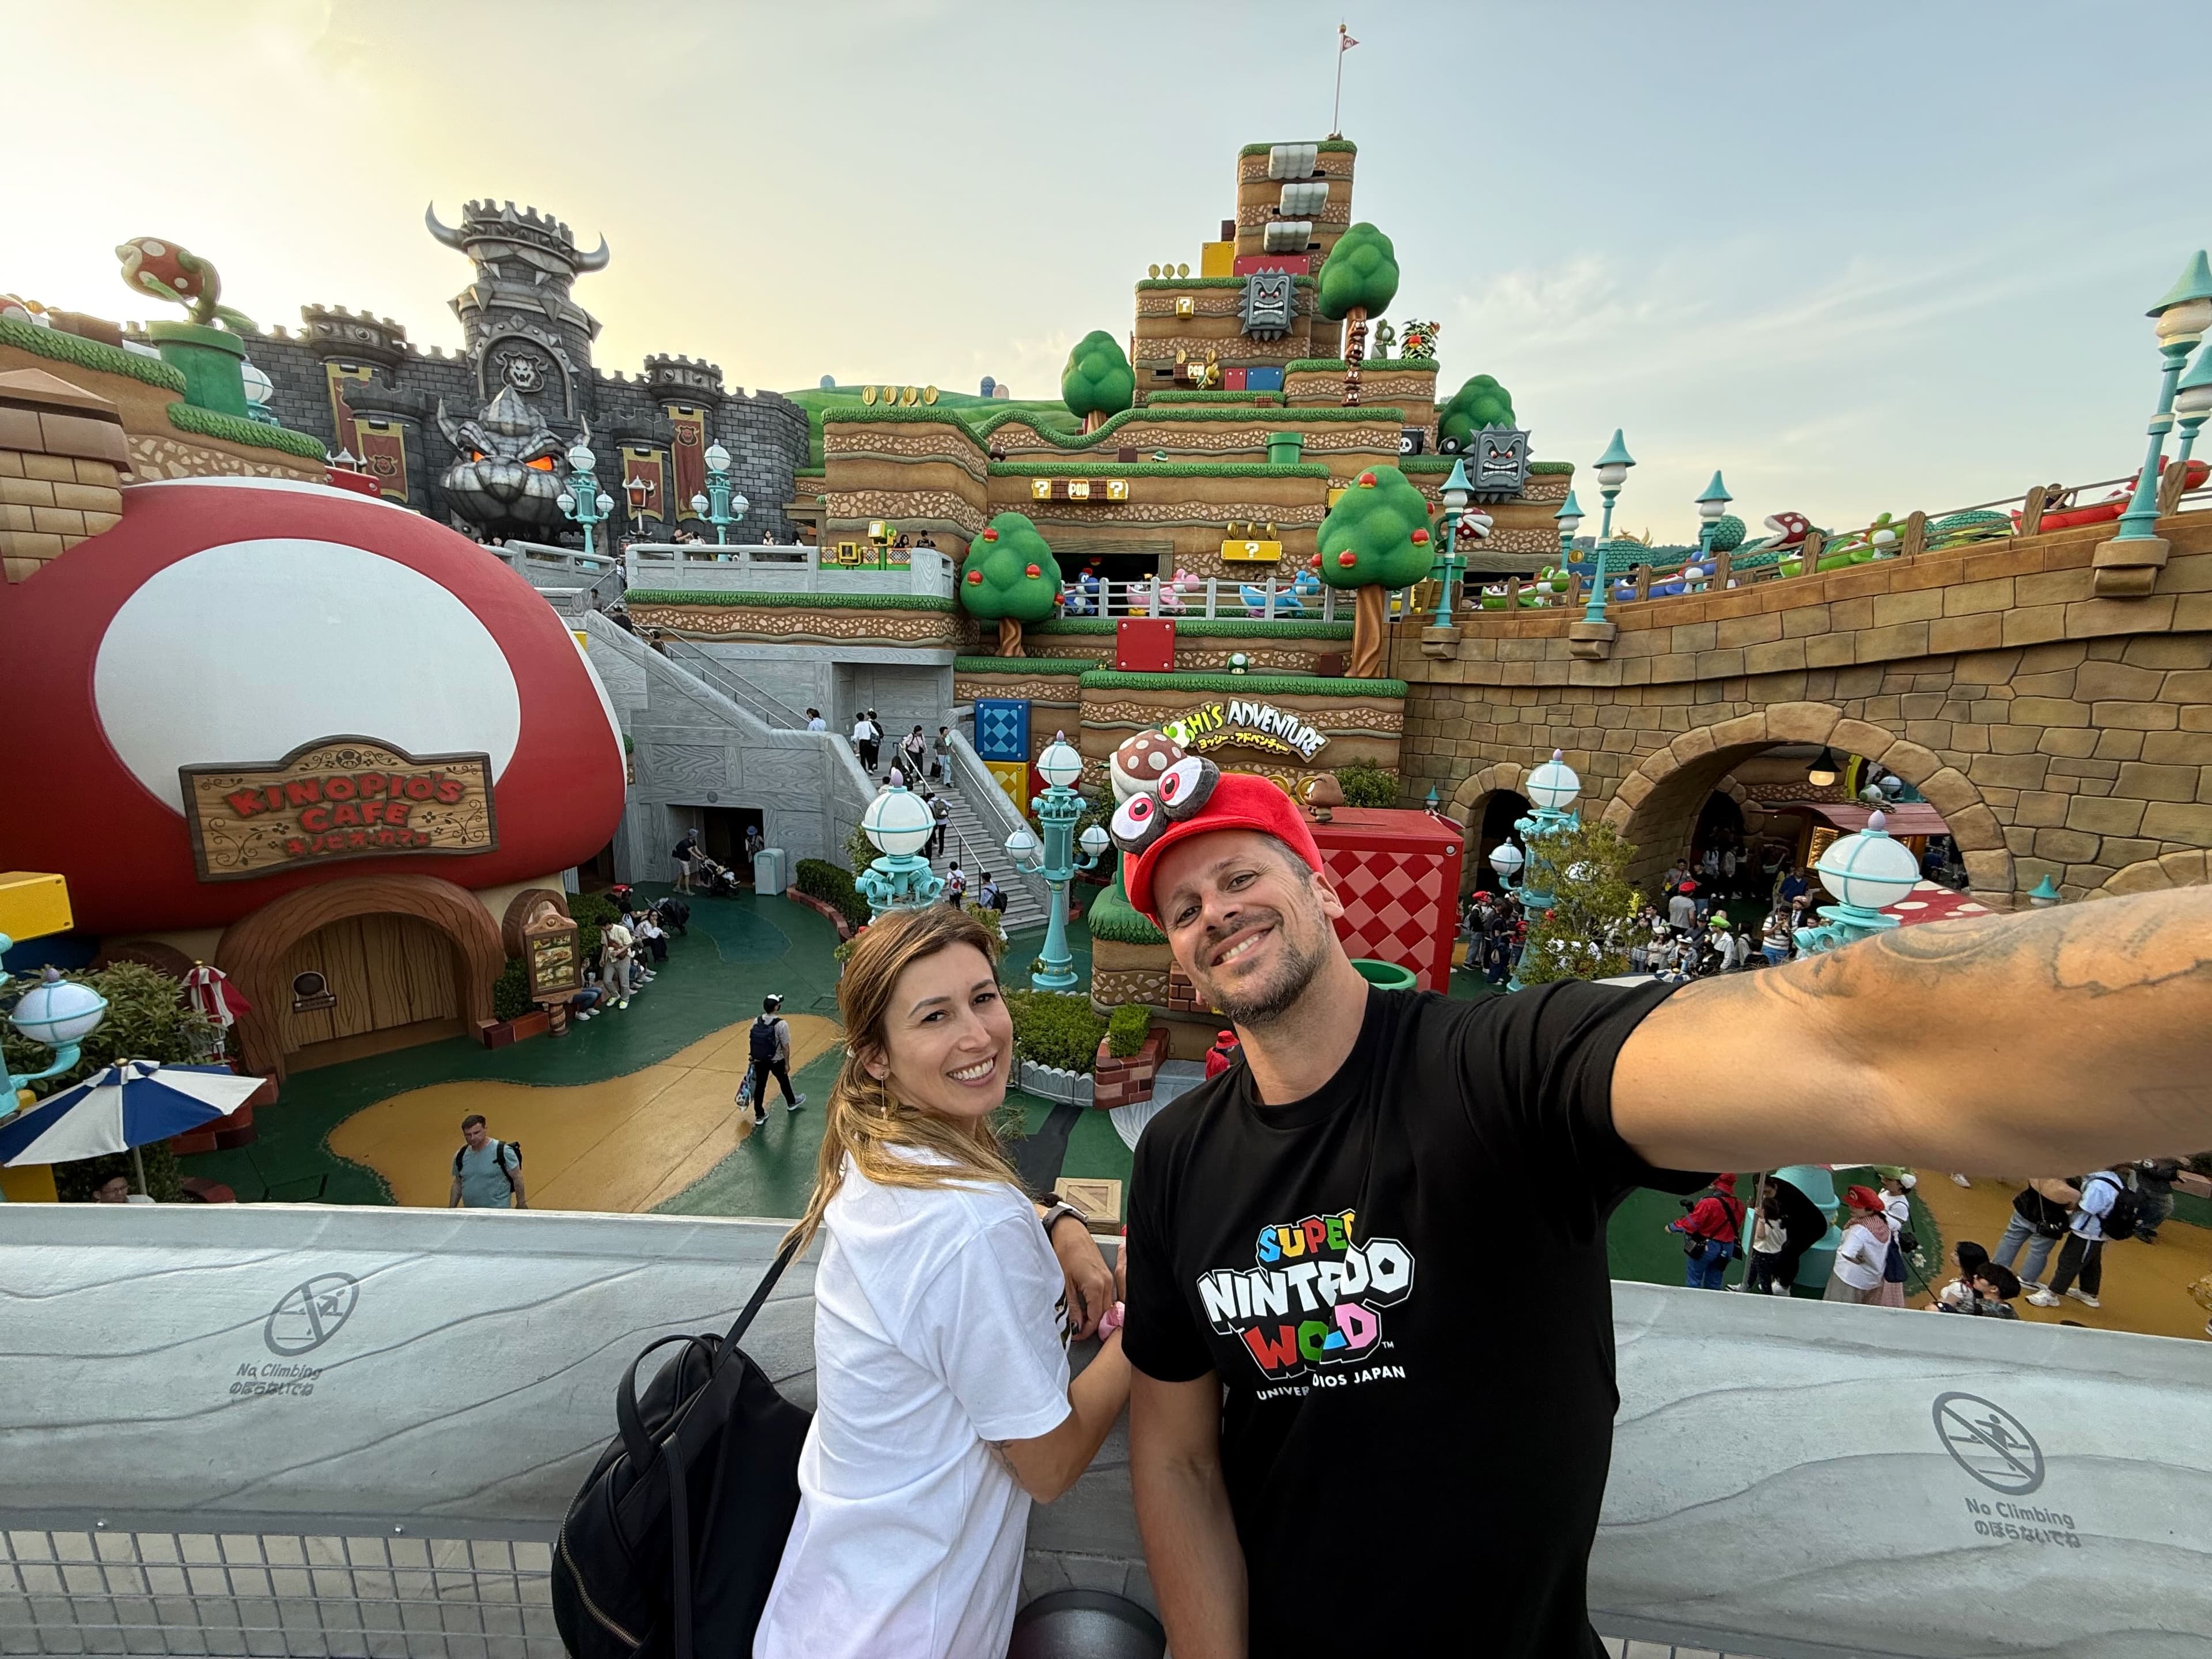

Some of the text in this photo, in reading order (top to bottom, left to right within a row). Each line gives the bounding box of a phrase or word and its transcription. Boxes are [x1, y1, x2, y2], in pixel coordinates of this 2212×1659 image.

[1035, 481, 1123, 497] ? POW ?
[1245, 543, 1259, 558] ?
[1227, 700, 1326, 756] ADVENTURE
[1198, 732, 1289, 752] ヨッシー・アドベンチャー
[226, 771, 464, 817] KINOPIO'S
[299, 801, 410, 831] CAFE
[1199, 1242, 1411, 1322] NINTEDO
[261, 1363, 322, 1380] Climbing
[1354, 1366, 1406, 1384] JAPAN
[1965, 1498, 2075, 1529] No Climbing
